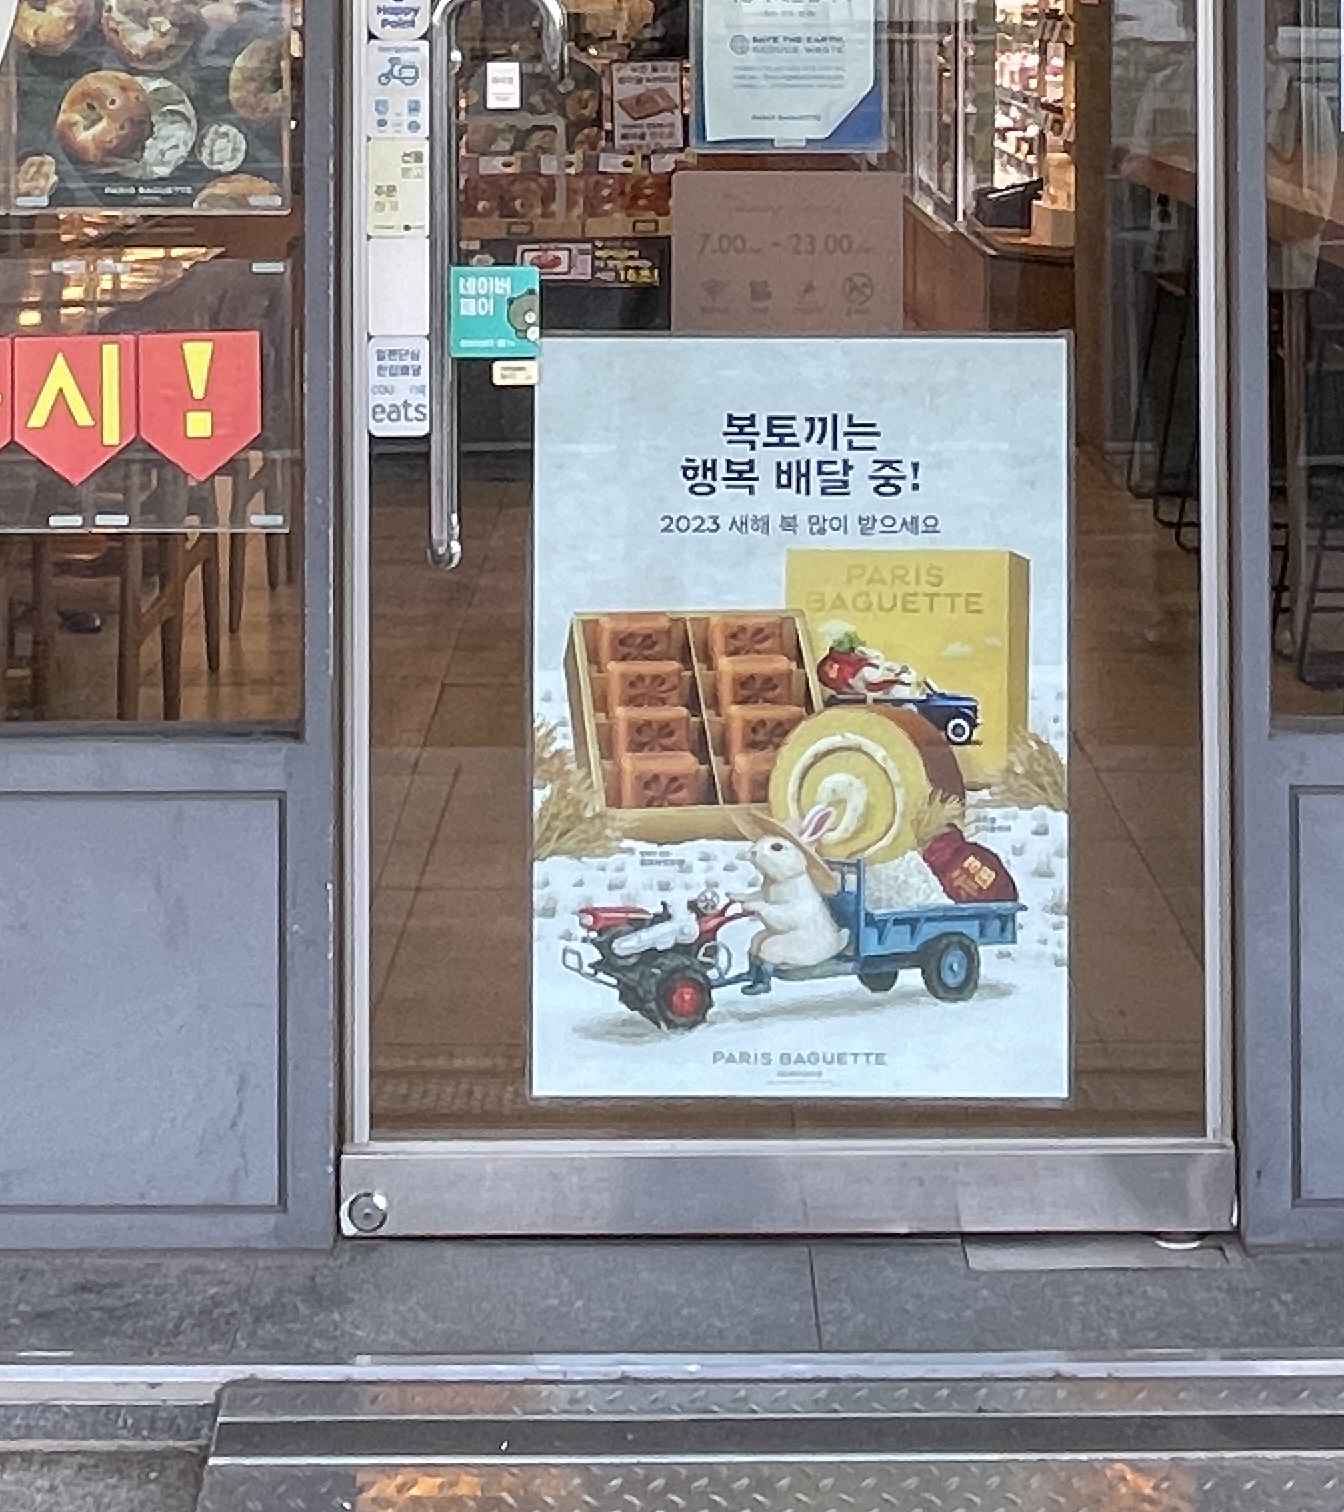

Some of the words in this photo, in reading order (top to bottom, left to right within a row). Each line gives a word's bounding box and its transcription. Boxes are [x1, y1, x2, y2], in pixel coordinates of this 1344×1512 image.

[459, 276, 511, 295] 네이버
[372, 399, 427, 423] eats
[722, 413, 882, 452] 복토끼는
[680, 457, 760, 496] 행복
[775, 458, 853, 496] 배달
[867, 459, 922, 496] 중!
[660, 515, 722, 534] 2023
[728, 514, 770, 536] 새해
[779, 514, 799, 536] 복
[808, 514, 849, 536] 많이
[858, 514, 941, 536] 받으세요
[847, 562, 945, 588] PARIS
[806, 591, 985, 615] BAGUETTE
[711, 1050, 774, 1067] PARIS
[779, 1051, 888, 1067] BAGUETTE
